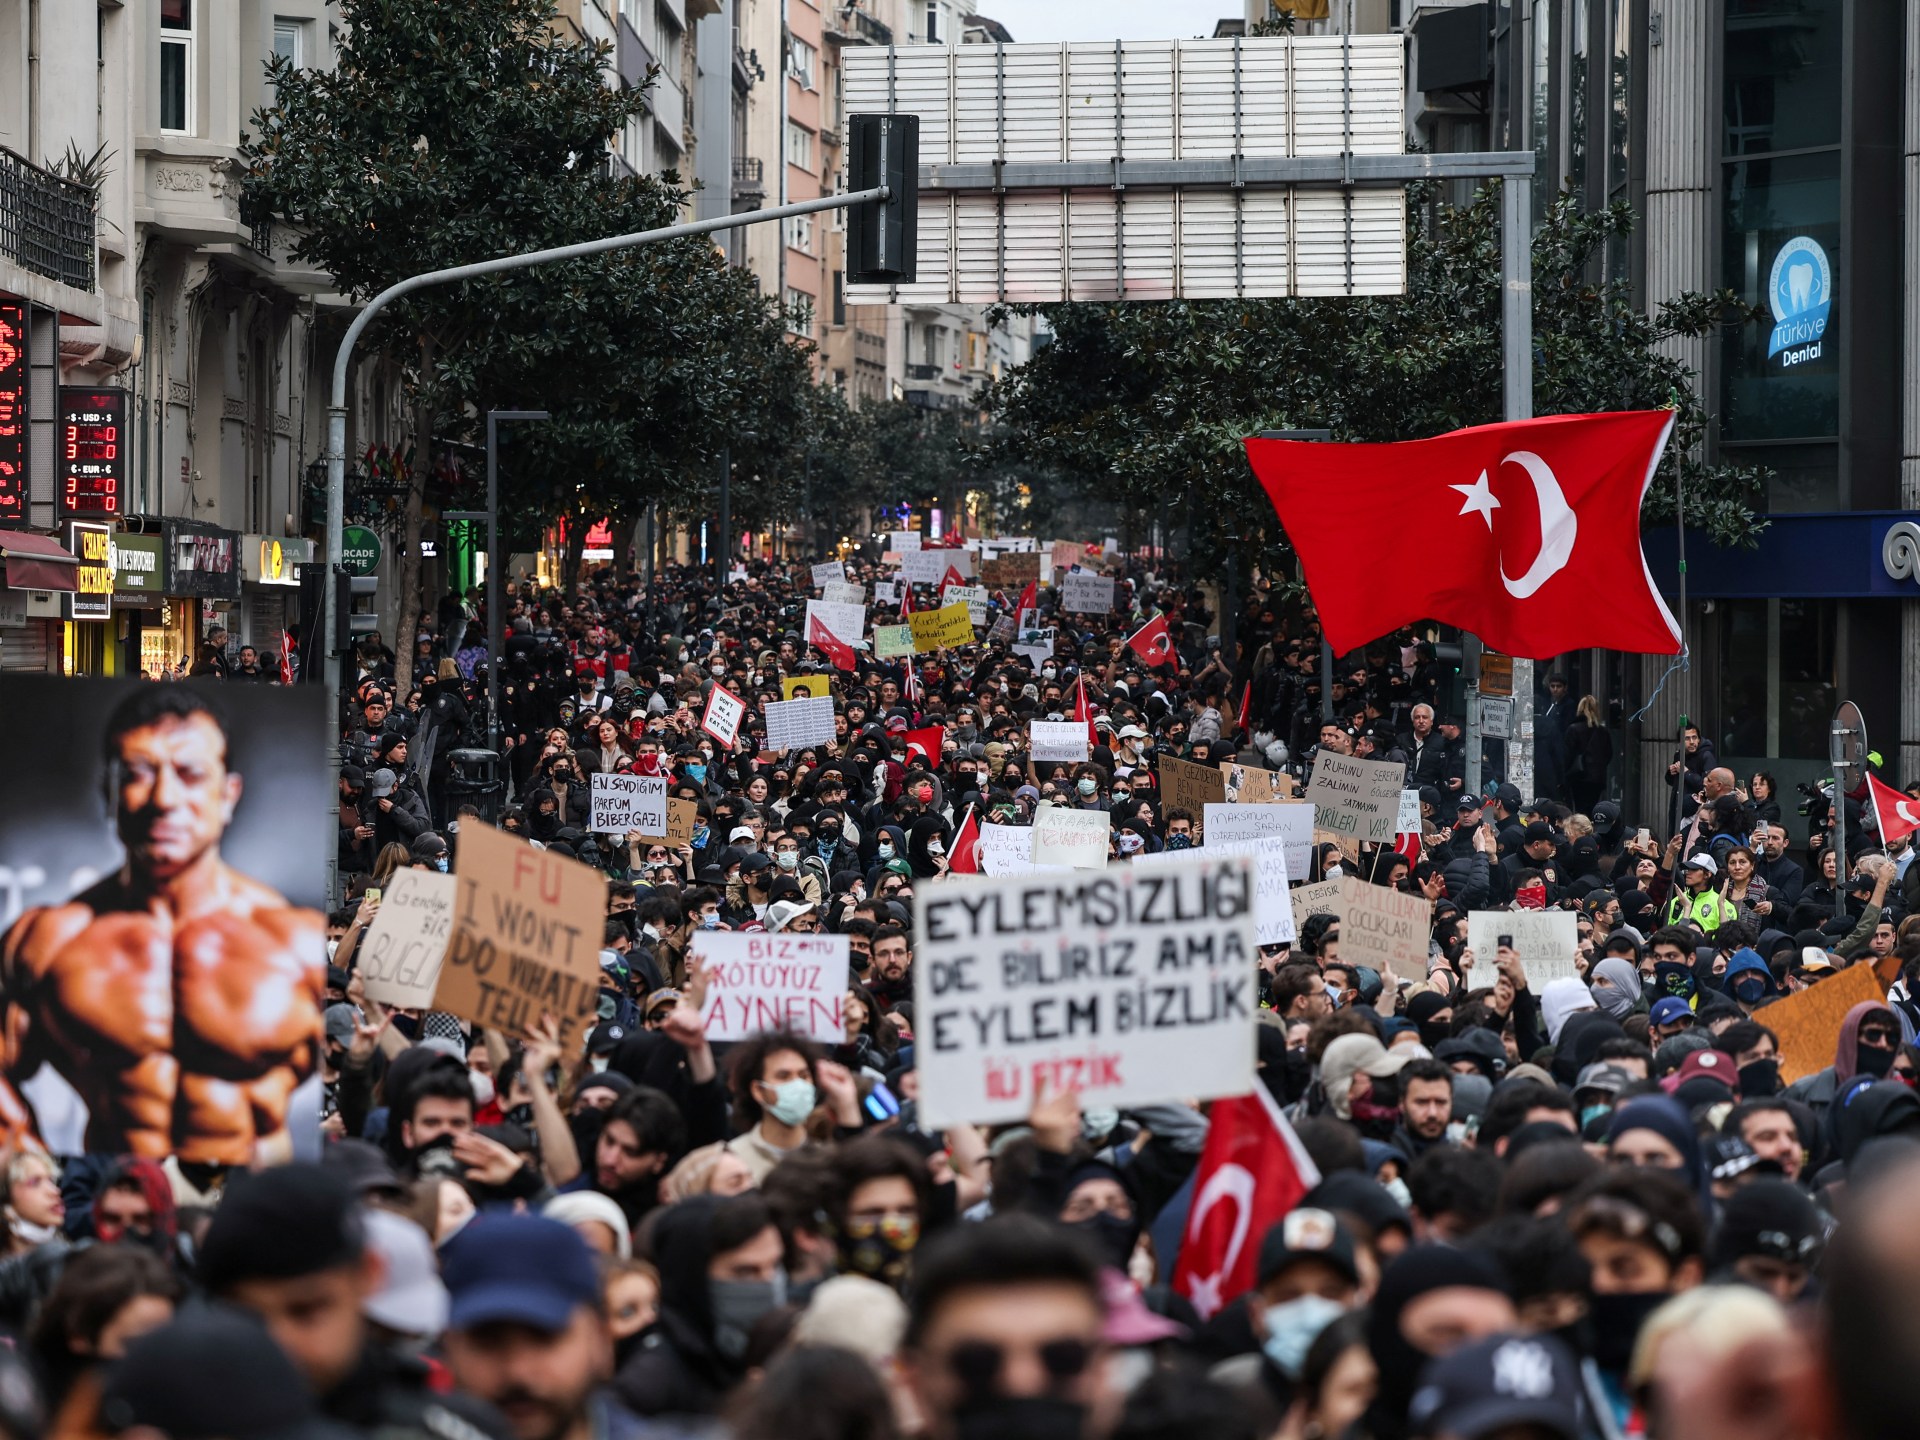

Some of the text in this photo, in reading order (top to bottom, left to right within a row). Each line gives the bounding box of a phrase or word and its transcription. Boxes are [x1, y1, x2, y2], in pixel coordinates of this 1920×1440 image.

[1775, 318, 1825, 347] Türkiye
[1783, 341, 1821, 367] Dental
[83, 413, 100, 422] USD
[83, 465, 100, 474] EUR
[421, 541, 435, 550] SY
[133, 550, 155, 571] ROCHER
[80, 566, 113, 594] EXCHANGE
[949, 587, 979, 597] ADALET
[719, 696, 734, 709] DON'T
[719, 706, 725, 714] BE
[709, 717, 731, 737] EAT ONE
[1323, 758, 1364, 778] RUHUNU
[592, 775, 608, 790] EN
[1177, 777, 1209, 800] BEN DE
[1316, 776, 1360, 794] ZALİMİN
[594, 796, 631, 811] PARFÜM
[1341, 798, 1379, 813] SATMAYAN
[1254, 821, 1292, 832] SARAN
[1314, 804, 1389, 838] BİRİLERİ VAR
[513, 846, 563, 905] FU
[1257, 858, 1287, 876] VAR
[1255, 878, 1286, 898] AMA
[925, 860, 1252, 943] EYLEMSİZLİĞİ
[1305, 904, 1333, 918] DÖNER
[463, 878, 582, 964] I WON'T
[748, 935, 796, 960] BİZ
[451, 926, 497, 976] DO
[508, 952, 577, 1012] WHAT
[928, 929, 1248, 997] DE BİLİRİZ AMA
[712, 960, 822, 992] KÖTÜYÜZ
[475, 980, 532, 1031] TELL
[703, 994, 842, 1036] AYNEN
[931, 970, 1252, 1052] EYLEM BİZLİK
